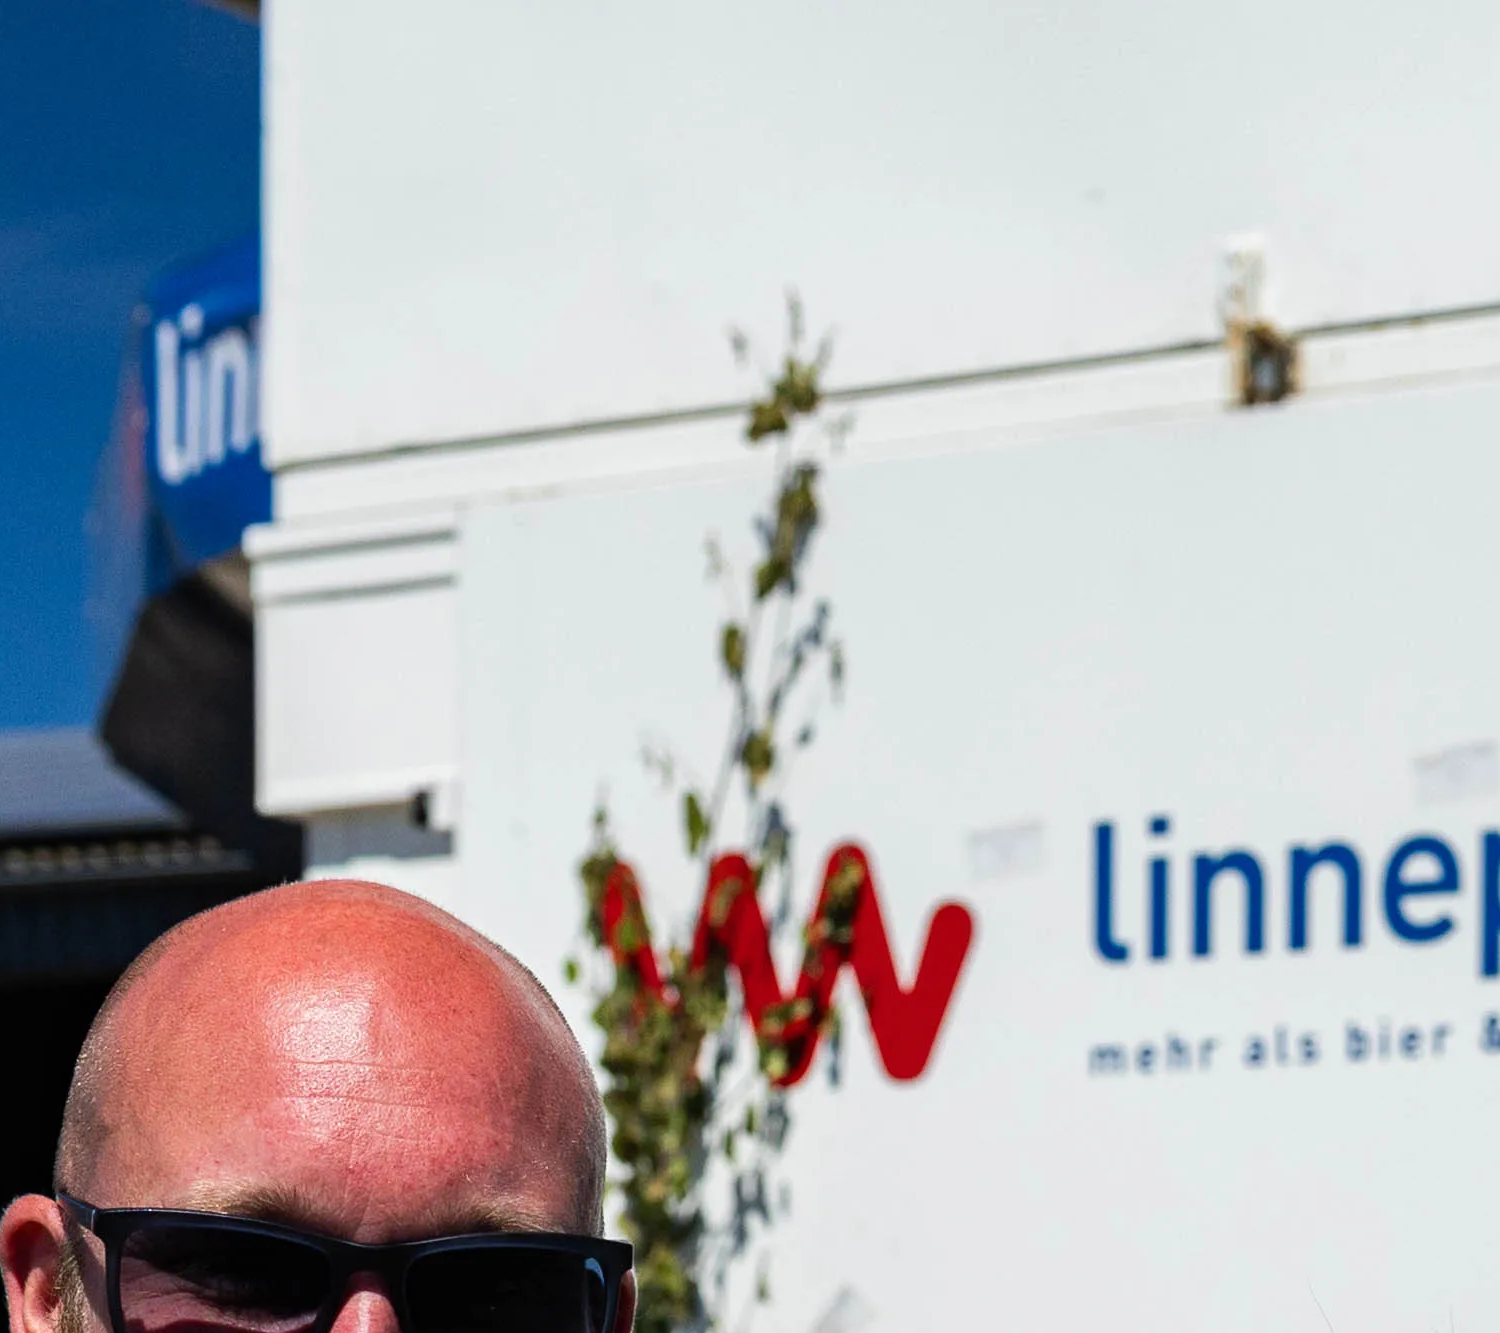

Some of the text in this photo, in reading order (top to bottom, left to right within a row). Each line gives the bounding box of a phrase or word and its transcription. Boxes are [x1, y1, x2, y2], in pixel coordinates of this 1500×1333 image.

[1088, 1032, 1218, 1077] mehr
[1243, 1025, 1319, 1067] als
[1346, 1018, 1453, 1064] bier
